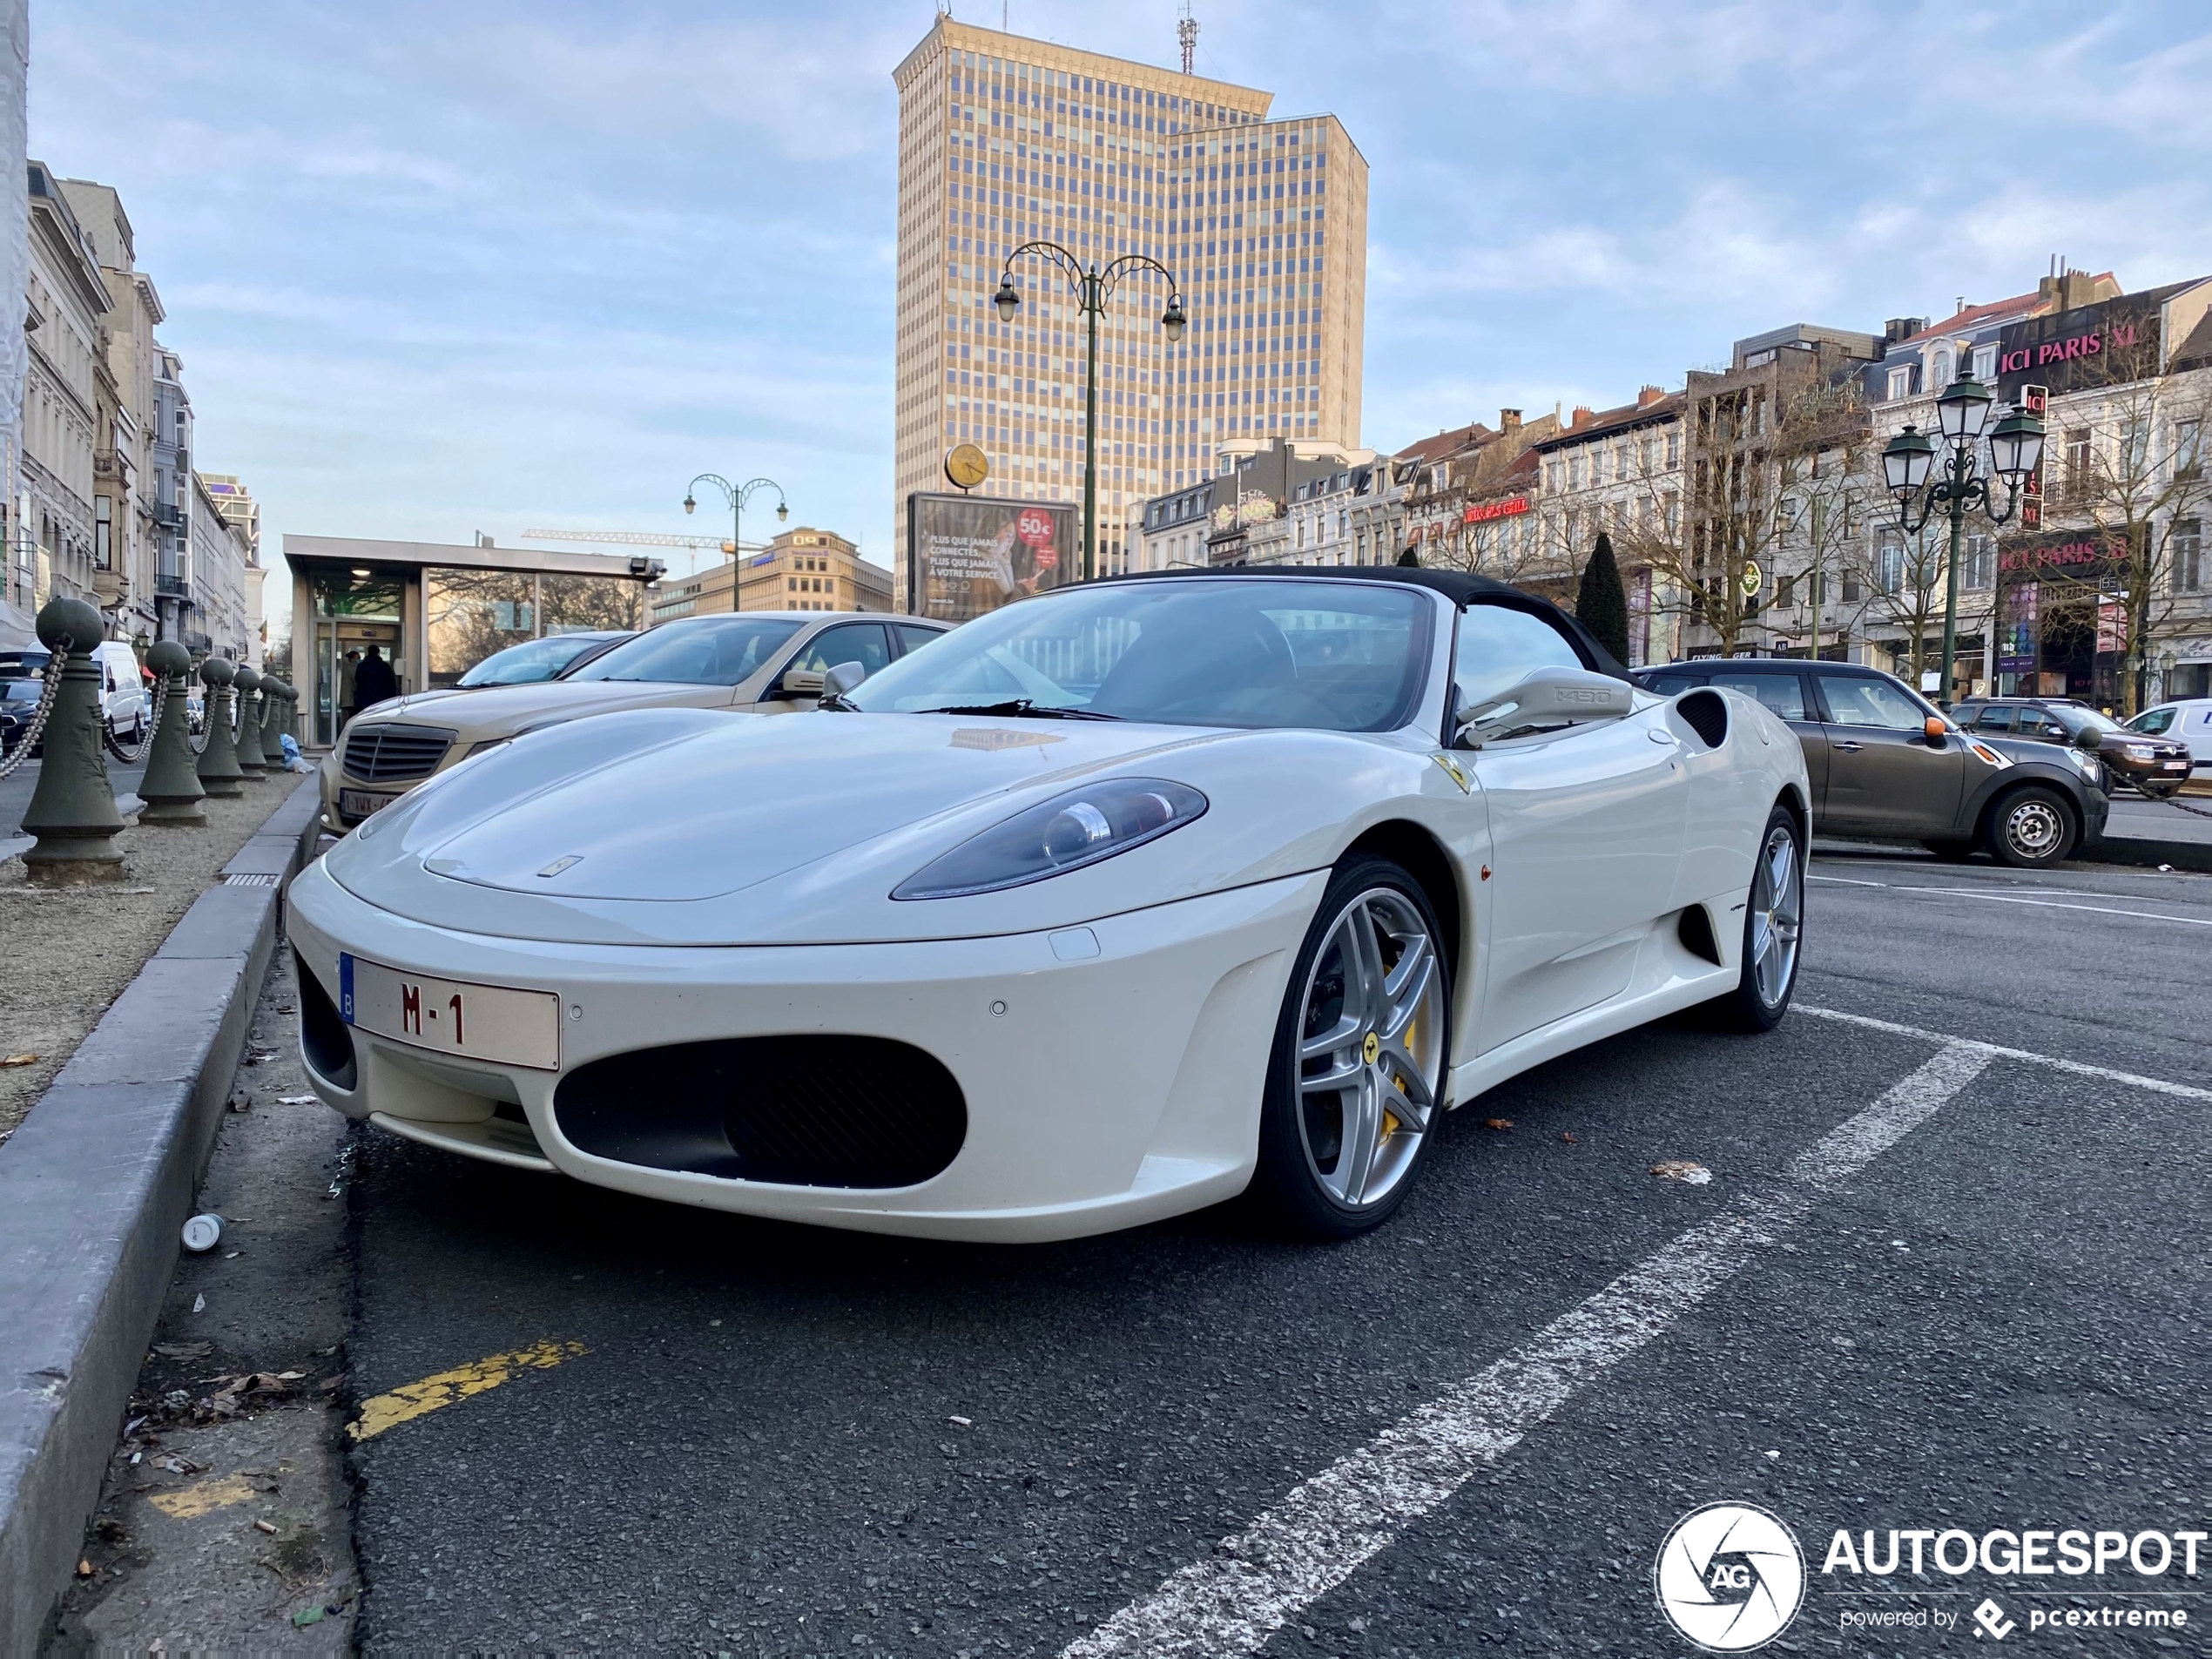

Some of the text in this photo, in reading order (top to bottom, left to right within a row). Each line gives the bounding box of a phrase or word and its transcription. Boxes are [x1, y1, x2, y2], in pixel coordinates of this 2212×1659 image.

[2002, 325, 2140, 373] ICI PARIS XL
[2027, 395, 2045, 411] ICI
[1503, 499, 1528, 515] GRILL
[1020, 517, 1050, 535] 50€
[929, 536, 999, 547] PLUS QUE JAMAIS
[929, 557, 999, 569] PLUS QUE JAMAIS
[2037, 542, 2095, 569] PARIS
[929, 565, 936, 577] À
[936, 569, 964, 577] VOTRE
[1692, 653, 1723, 662] FLYING
[345, 994, 352, 1015] B
